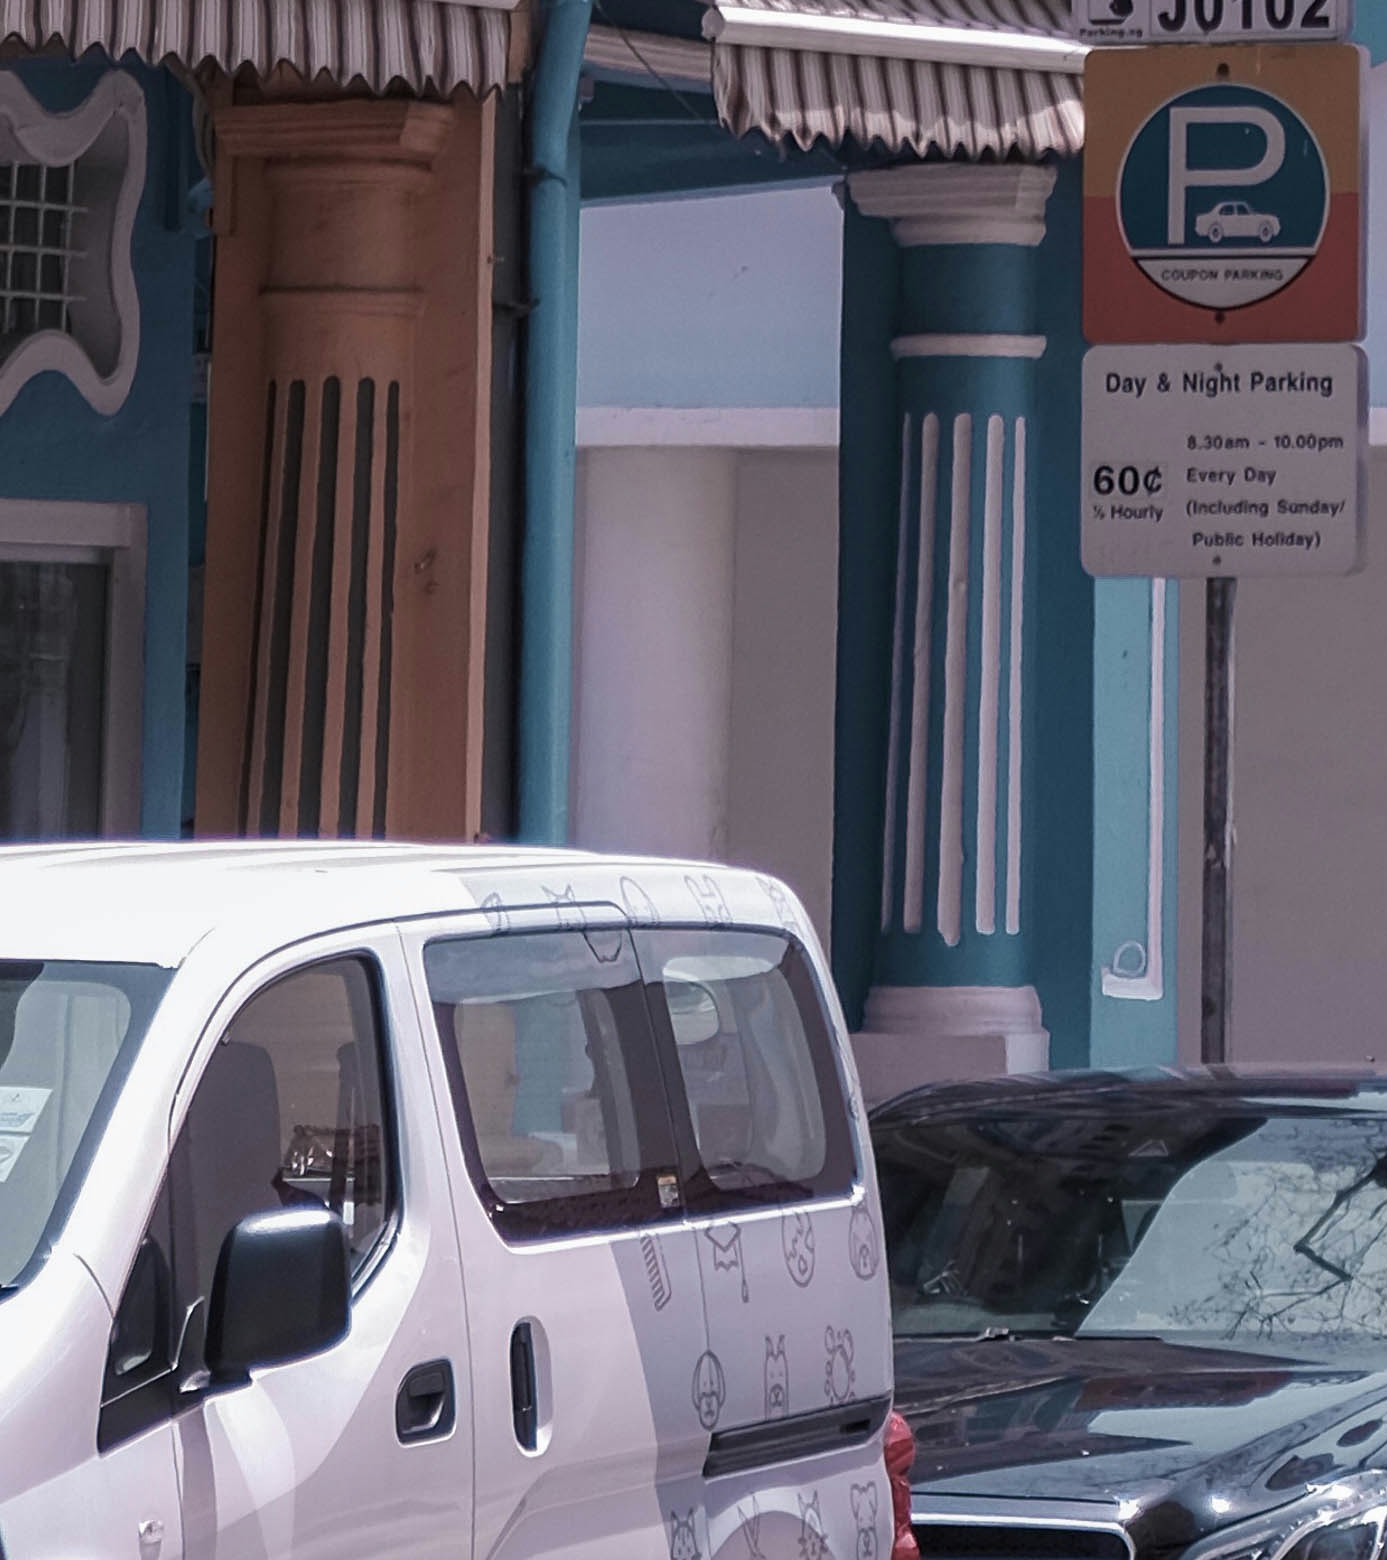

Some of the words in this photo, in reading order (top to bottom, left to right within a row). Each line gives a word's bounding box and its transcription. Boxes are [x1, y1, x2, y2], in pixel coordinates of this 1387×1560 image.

[1167, 105, 1286, 245] P
[1161, 269, 1218, 282] COUPON
[1224, 269, 1284, 282] PARKING
[1105, 372, 1146, 398] Day
[1156, 372, 1171, 393] &
[1183, 372, 1241, 398] Night
[1251, 371, 1333, 398] Parking
[1186, 434, 1250, 451] 8.30am
[1274, 433, 1344, 452] 10.00pm
[1093, 465, 1163, 497] 60¢
[1186, 467, 1236, 486] Every
[1244, 467, 1277, 486] Day
[1111, 504, 1164, 522] Hourly
[1186, 499, 1269, 518] (Including
[1277, 499, 1345, 518] Sunday/
[1192, 532, 1243, 547] Public
[1251, 531, 1321, 549] Holiday)
